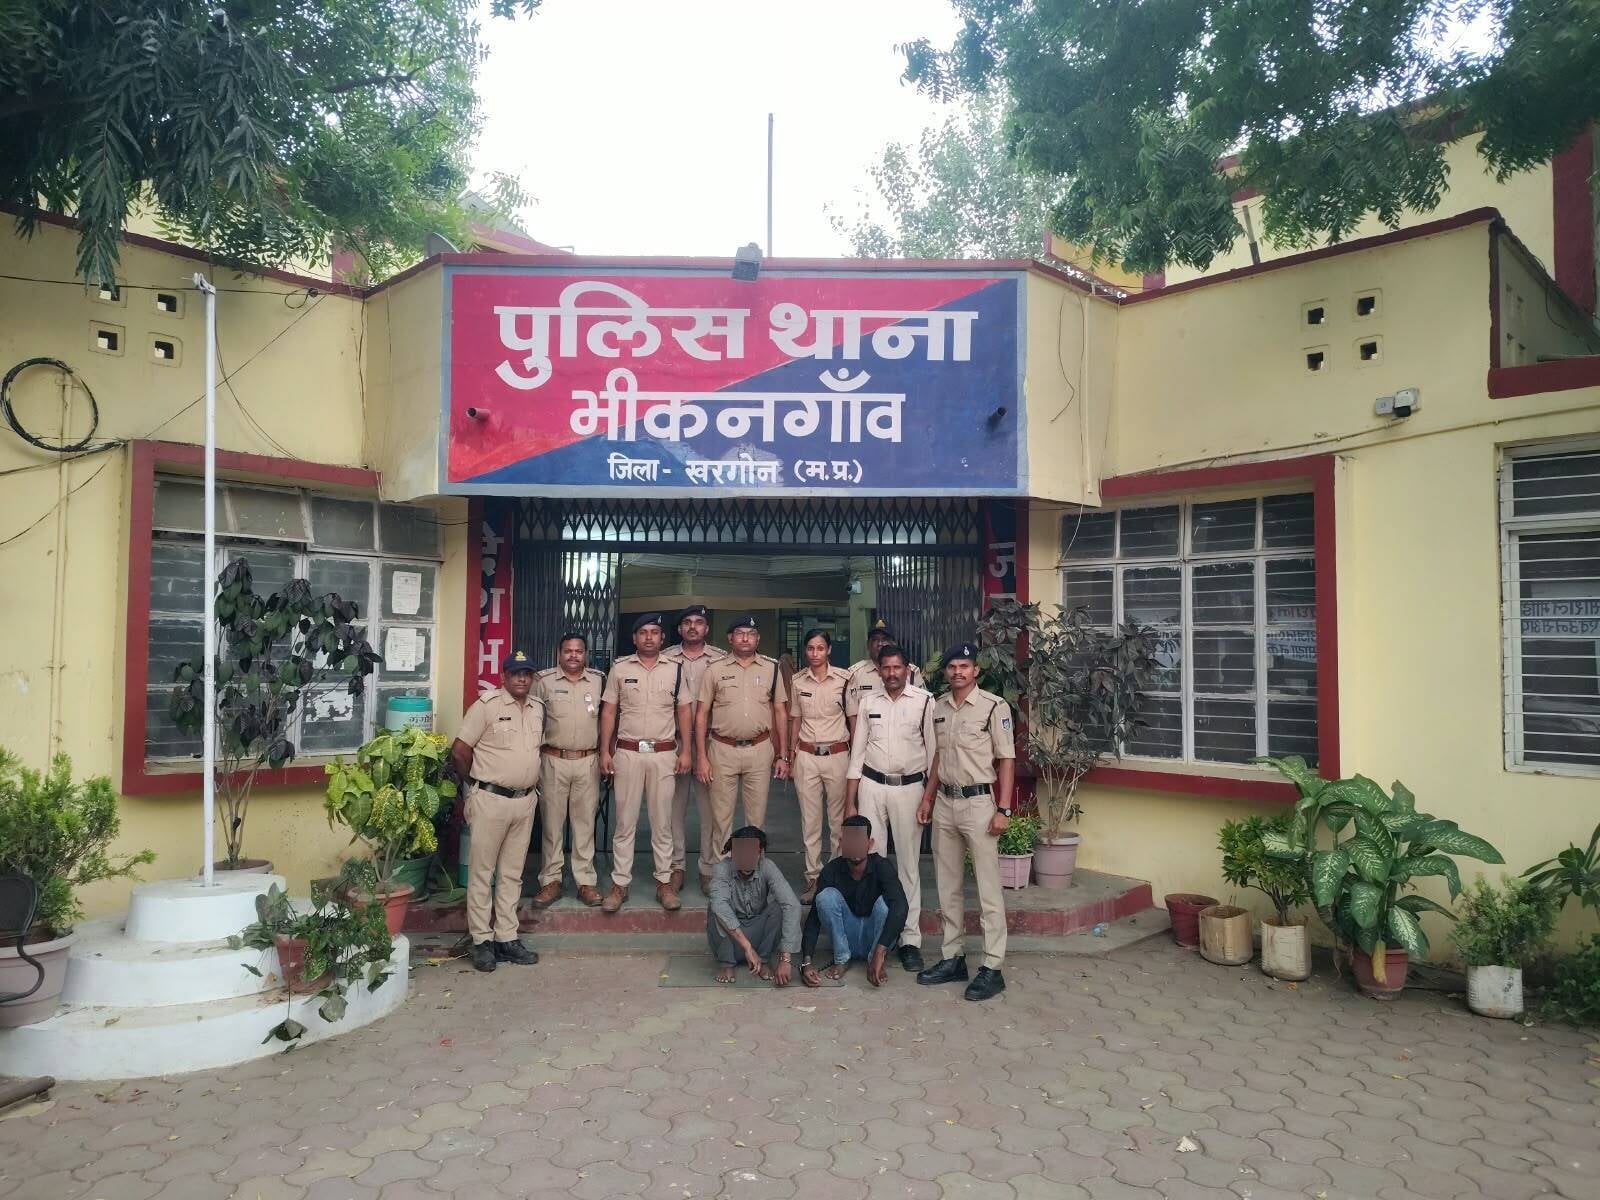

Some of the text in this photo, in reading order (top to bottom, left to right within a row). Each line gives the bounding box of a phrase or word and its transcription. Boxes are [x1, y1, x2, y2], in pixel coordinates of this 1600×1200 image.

[493, 281, 979, 390] पुलिस थाना
[570, 367, 906, 443] भीकनगाँव
[793, 459, 864, 484] (म.प्र.)
